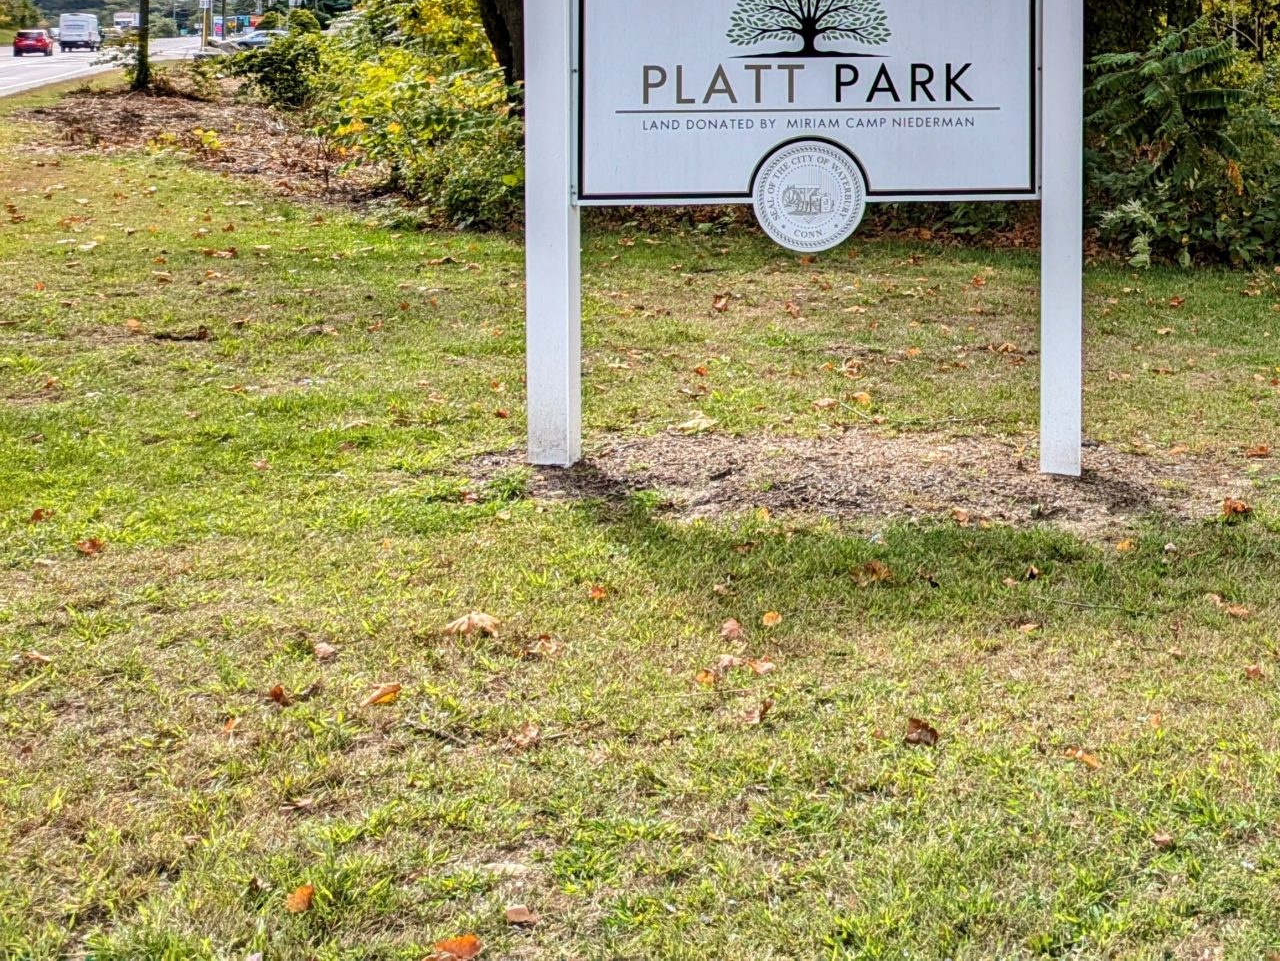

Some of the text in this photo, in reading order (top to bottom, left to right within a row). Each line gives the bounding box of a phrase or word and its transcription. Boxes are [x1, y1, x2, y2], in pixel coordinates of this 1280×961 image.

[642, 62, 974, 105] PLATT PARK
[642, 116, 975, 131] LAND DONATED BY MIRIAM CAMP NIEDERMAN
[767, 154, 852, 222] SEAL OF THE CITY OF WATERBURY
[794, 229, 826, 239] CONN.
